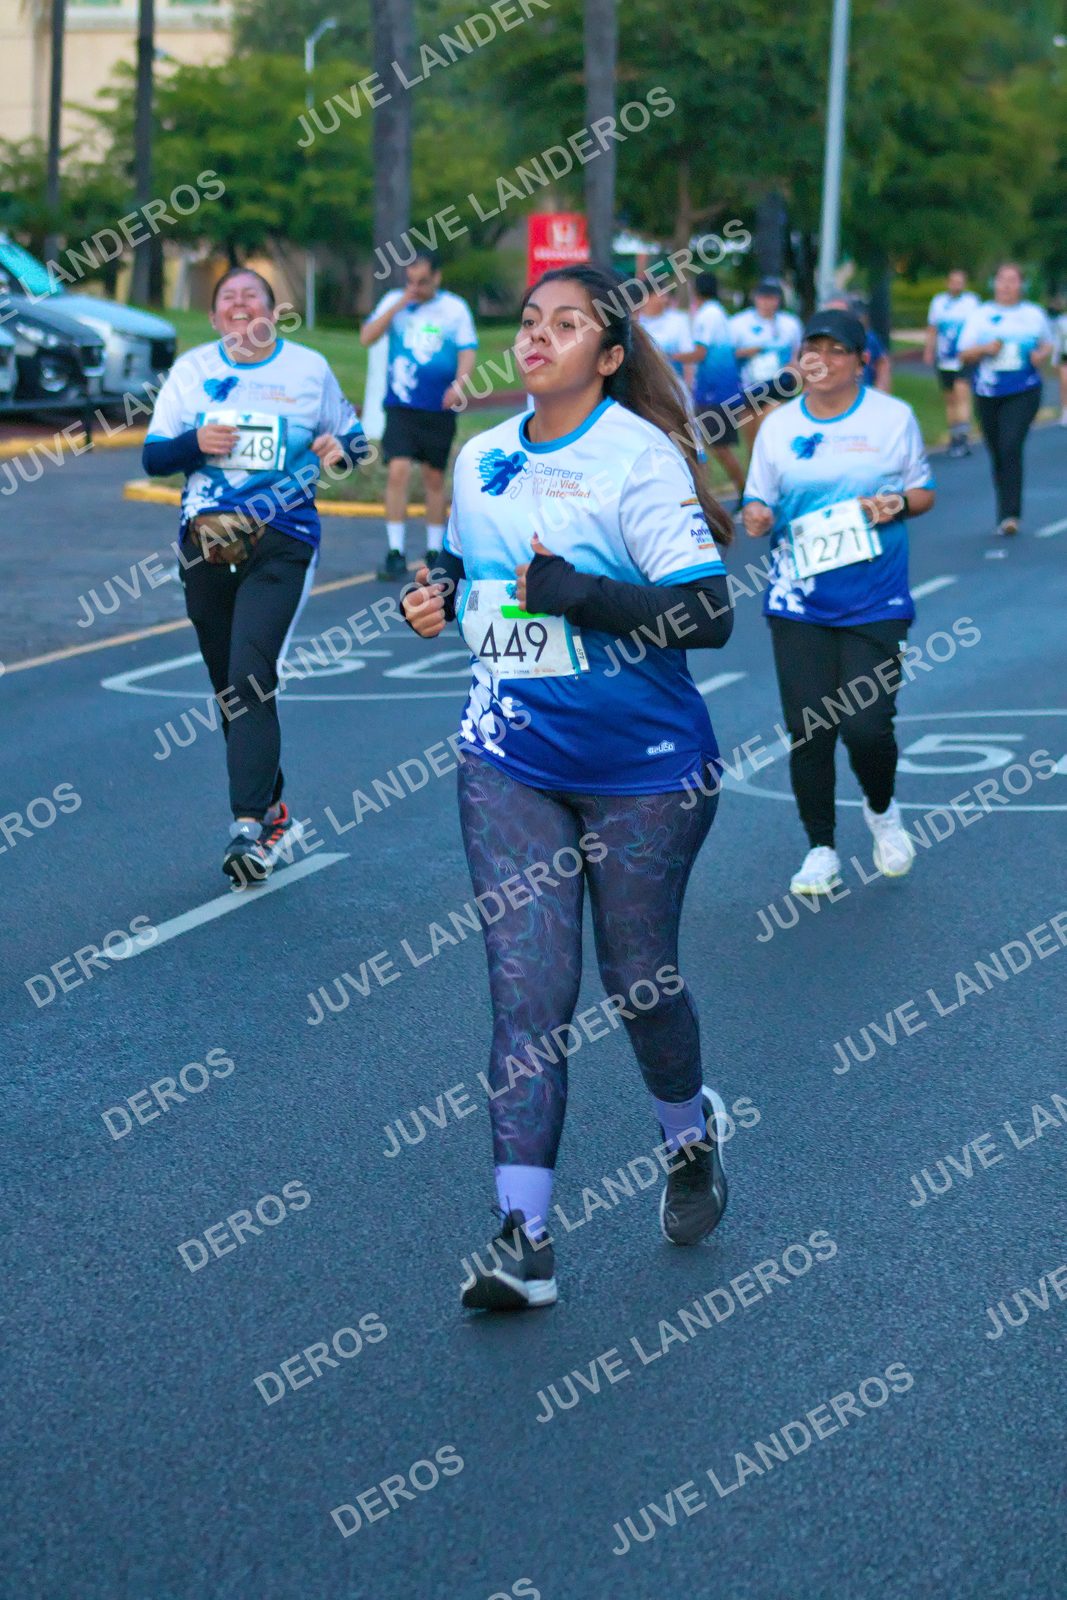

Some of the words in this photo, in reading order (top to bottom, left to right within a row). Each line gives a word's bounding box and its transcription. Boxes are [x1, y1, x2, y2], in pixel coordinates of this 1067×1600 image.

[534, 462, 584, 481] Carrera
[545, 488, 591, 499] Integdad
[800, 527, 862, 567] 1271
[479, 621, 548, 663] 449
